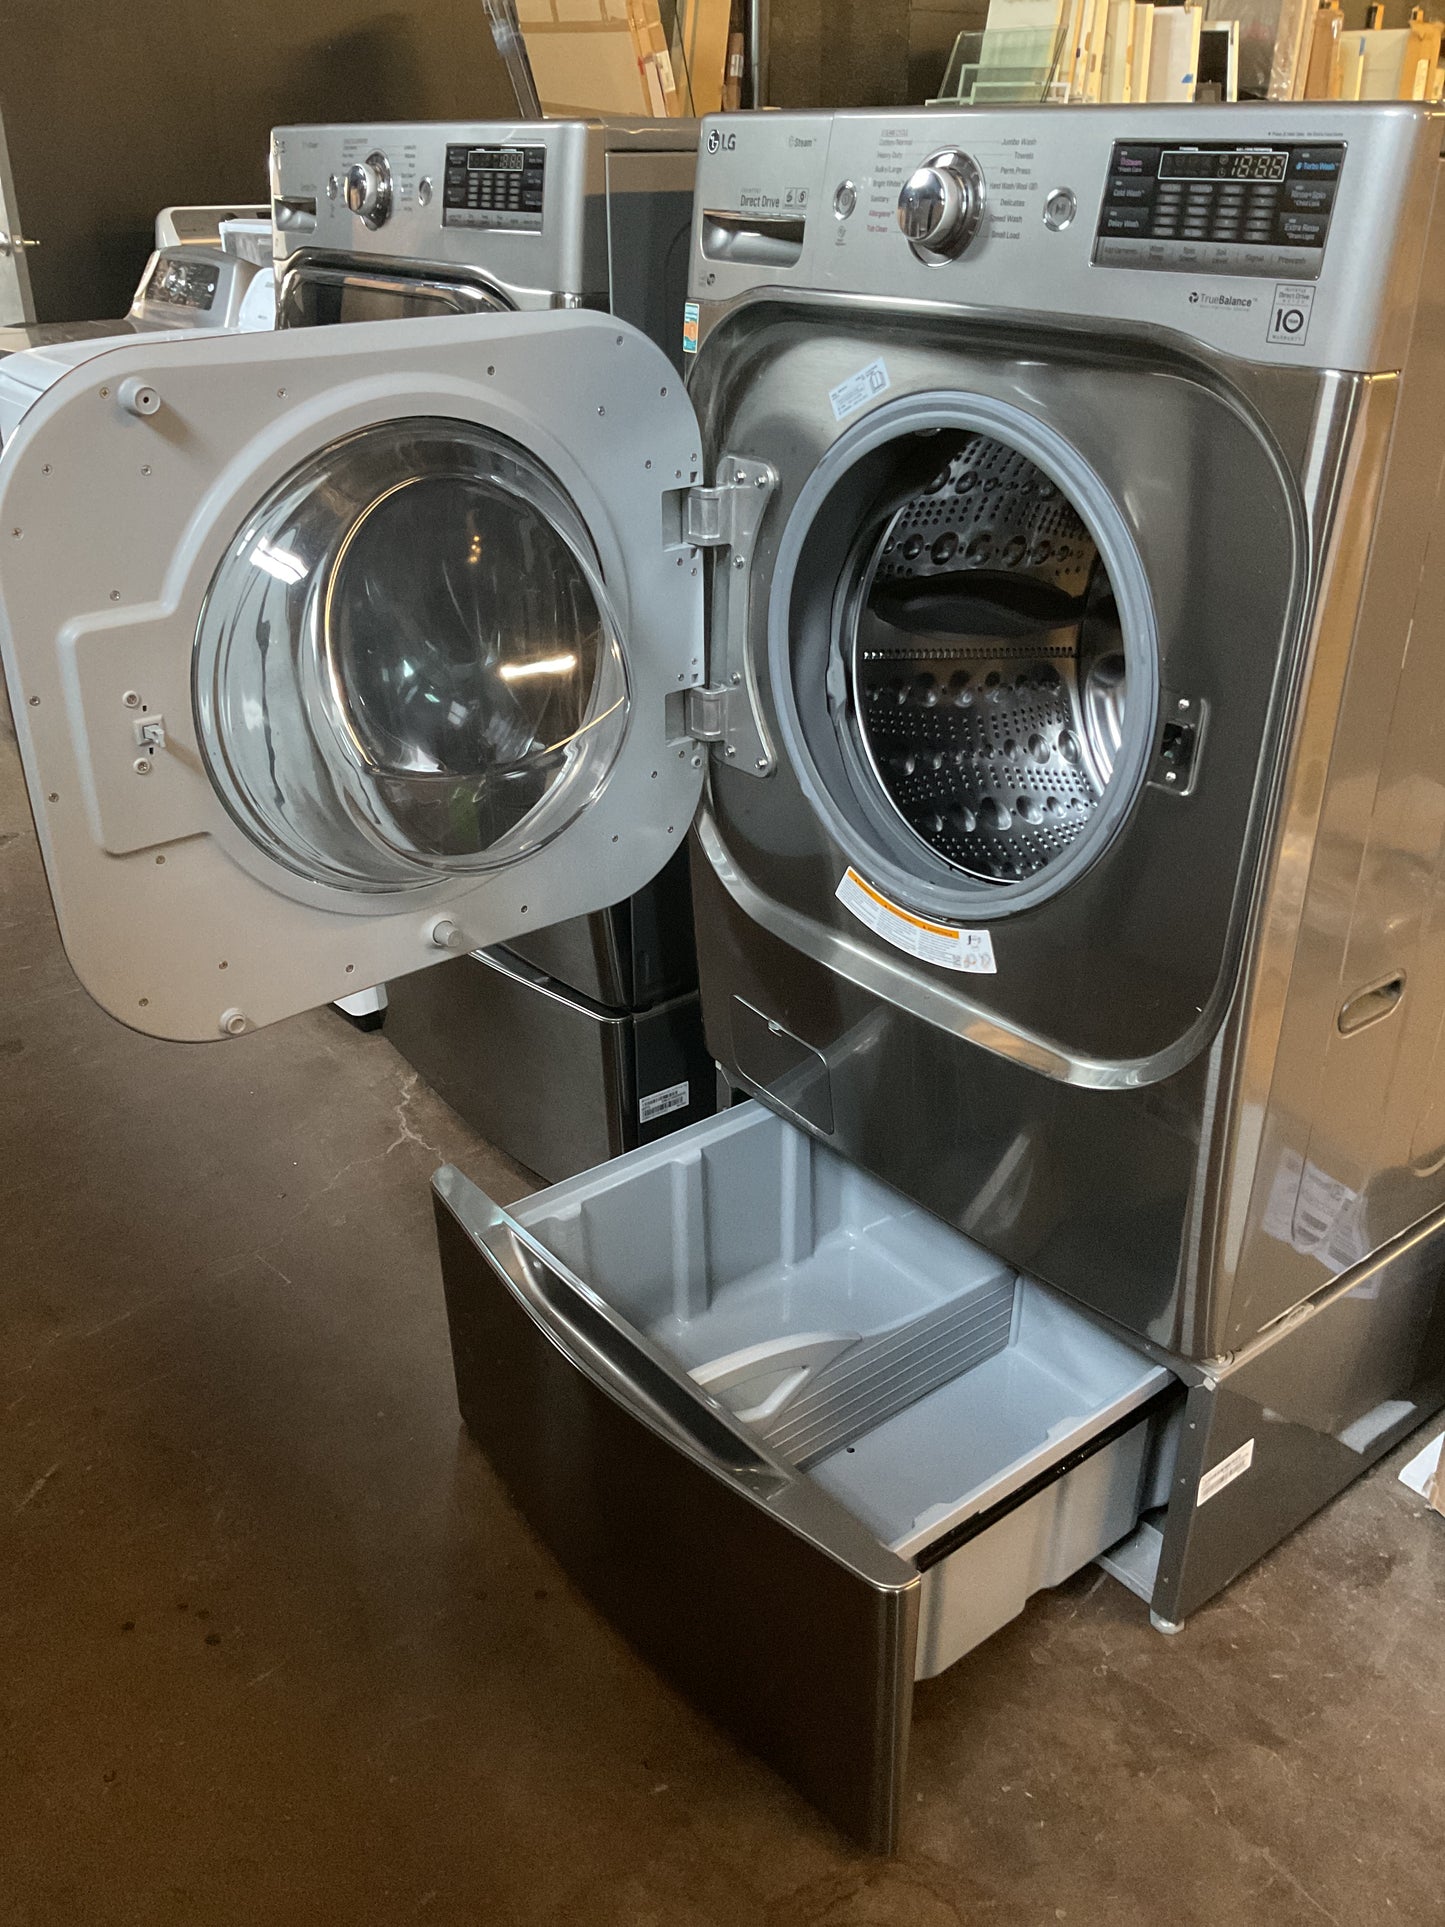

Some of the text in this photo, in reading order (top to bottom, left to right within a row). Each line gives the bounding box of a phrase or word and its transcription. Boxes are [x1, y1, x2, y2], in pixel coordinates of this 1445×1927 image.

[721, 133, 736, 151] LG
[740, 194, 760, 207] Direct
[761, 195, 780, 208] Drive
[1275, 308, 1304, 334] 10
